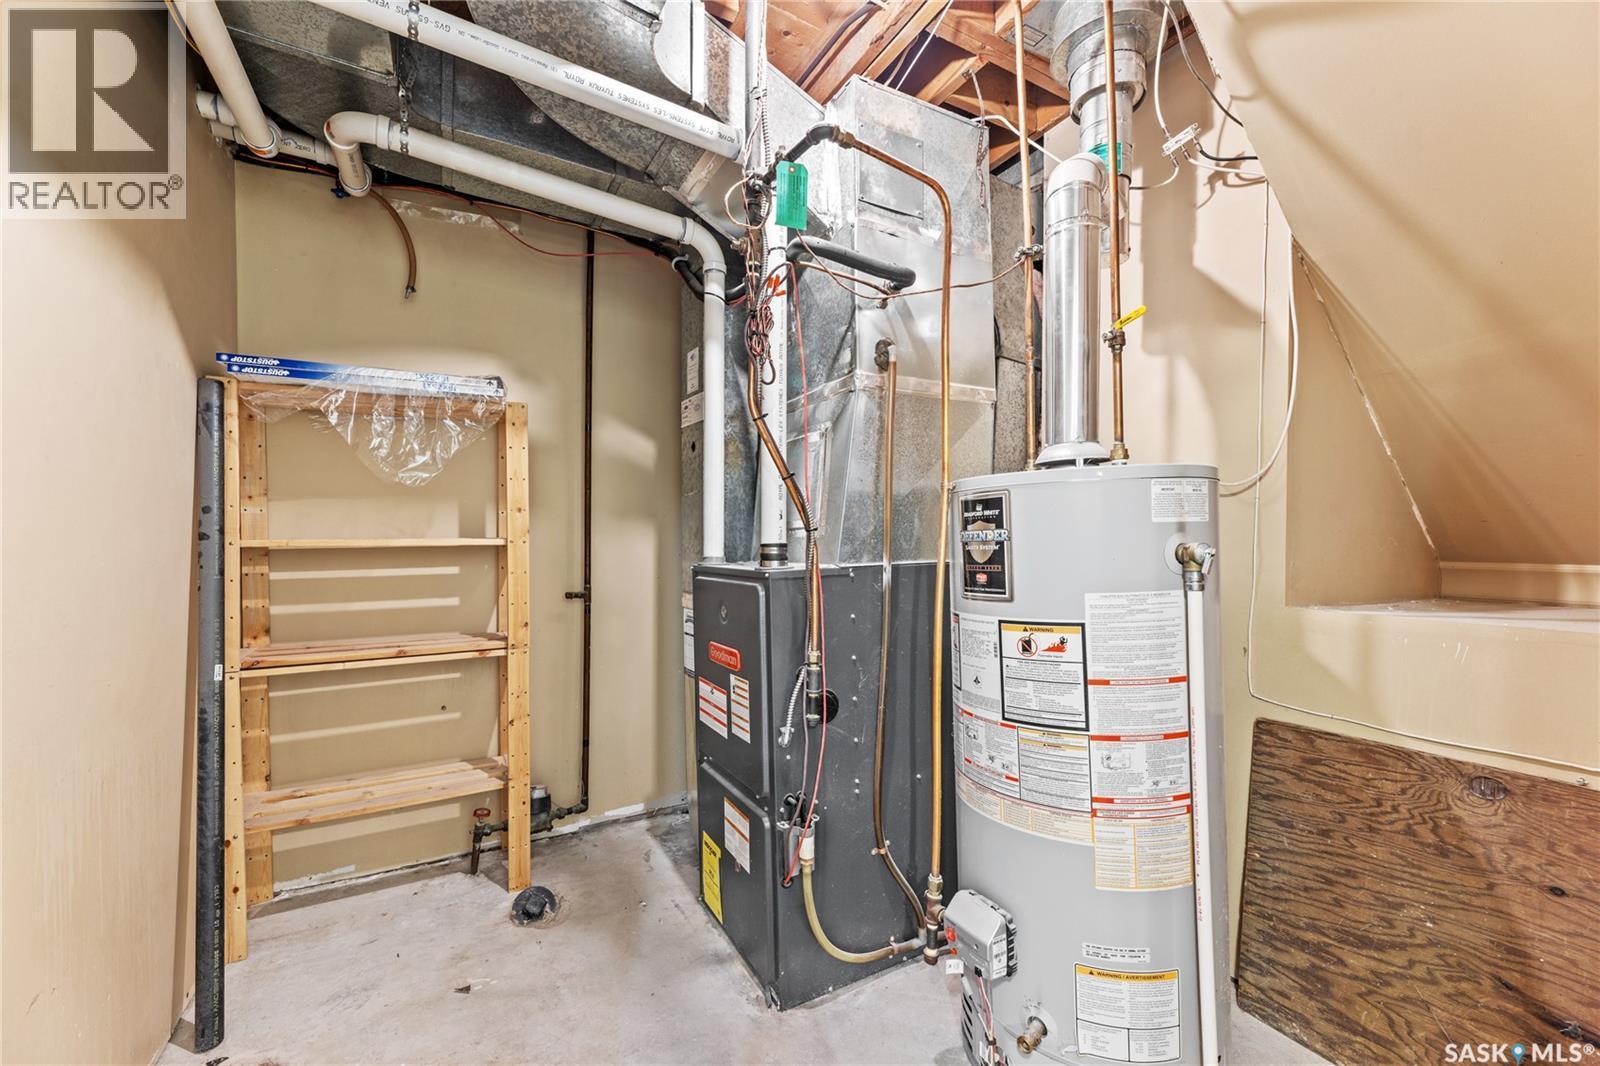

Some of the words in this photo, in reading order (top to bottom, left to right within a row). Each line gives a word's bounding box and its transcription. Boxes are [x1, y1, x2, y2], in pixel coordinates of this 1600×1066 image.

[563, 71, 584, 83] ROYAL
[230, 356, 274, 366] DUSTSTOP
[242, 366, 284, 376] DUSTSTOP
[960, 529, 1009, 542] DEFENDER
[710, 648, 736, 664] Goodman
[1096, 971, 1122, 979] WARNING
